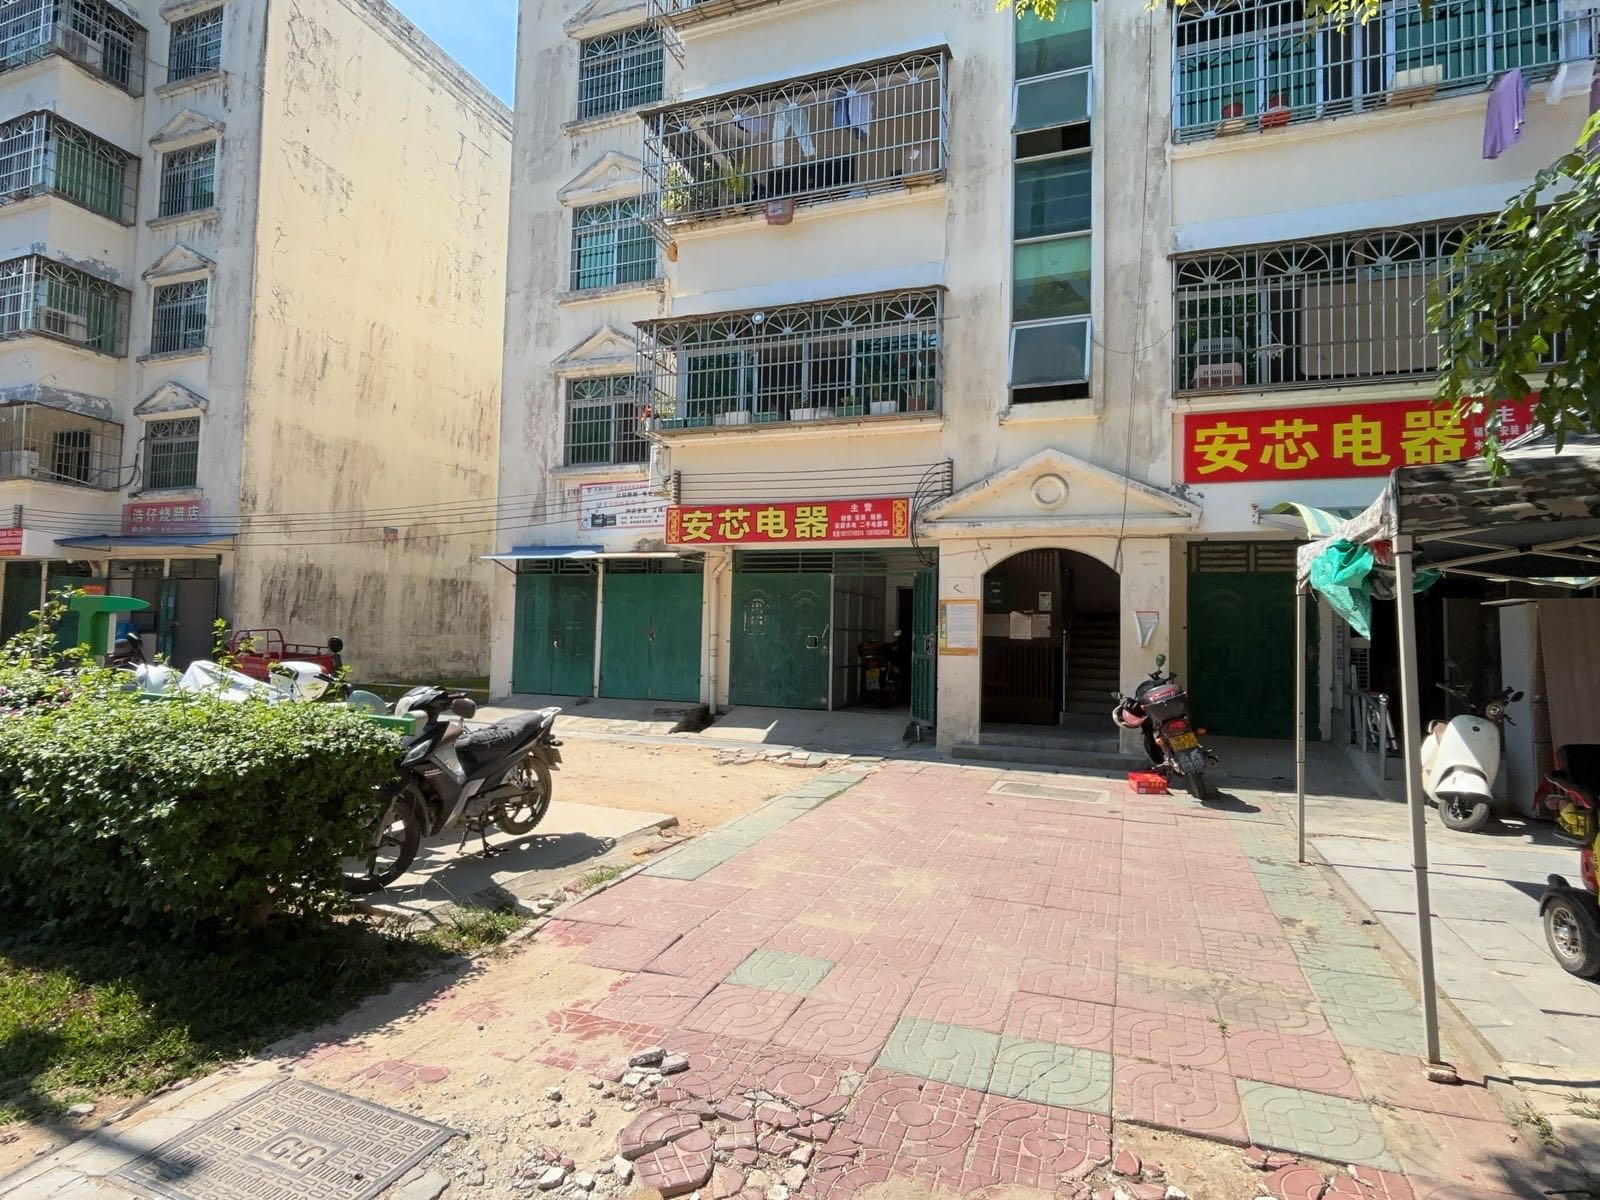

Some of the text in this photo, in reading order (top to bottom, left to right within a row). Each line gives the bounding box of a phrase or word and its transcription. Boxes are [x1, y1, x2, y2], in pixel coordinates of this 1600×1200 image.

[1193, 409, 1467, 475] 安芯电器
[681, 505, 830, 542] 安芯电器
